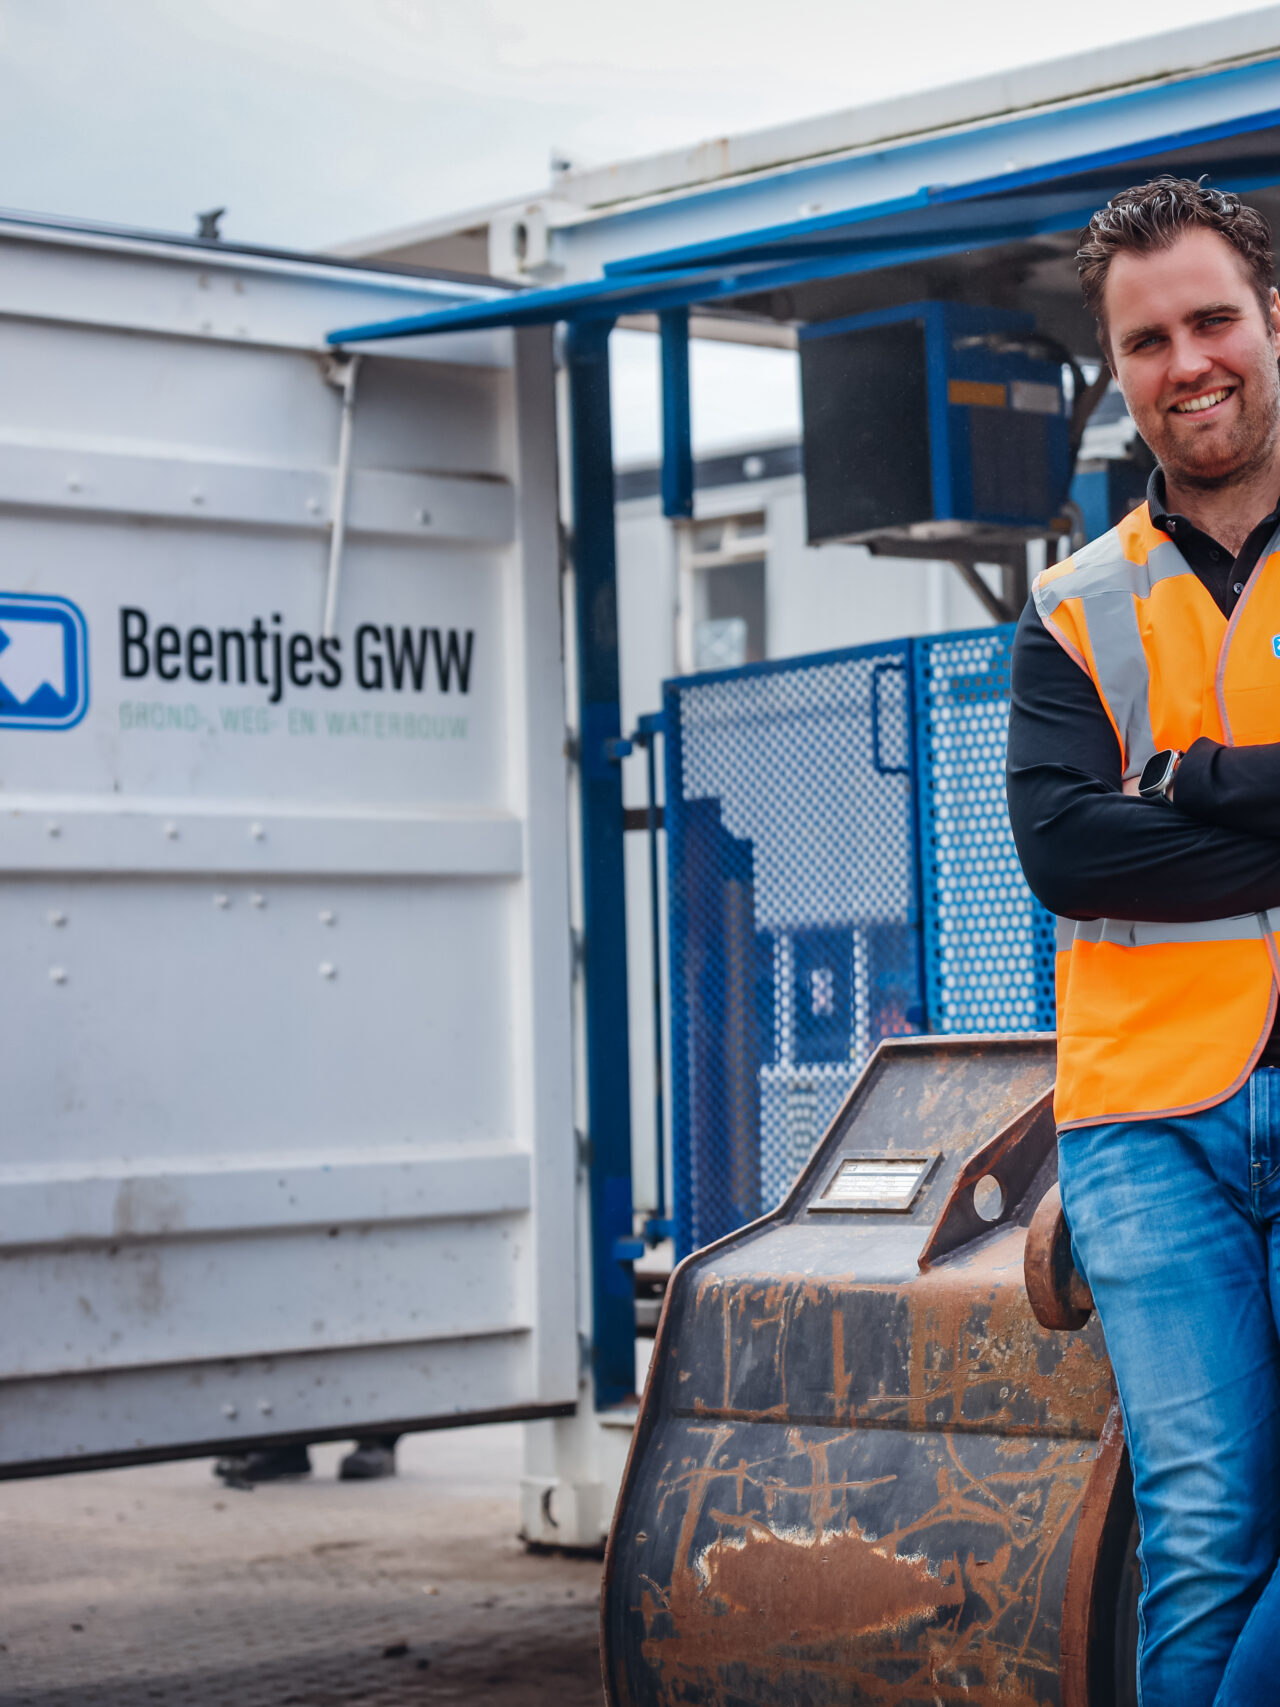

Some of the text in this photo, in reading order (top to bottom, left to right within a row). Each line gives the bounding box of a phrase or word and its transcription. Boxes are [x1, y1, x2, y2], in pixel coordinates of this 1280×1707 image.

[120, 607, 475, 703] Beentjes GWW
[287, 707, 315, 737] EN
[324, 709, 469, 741] WATERBOUW
